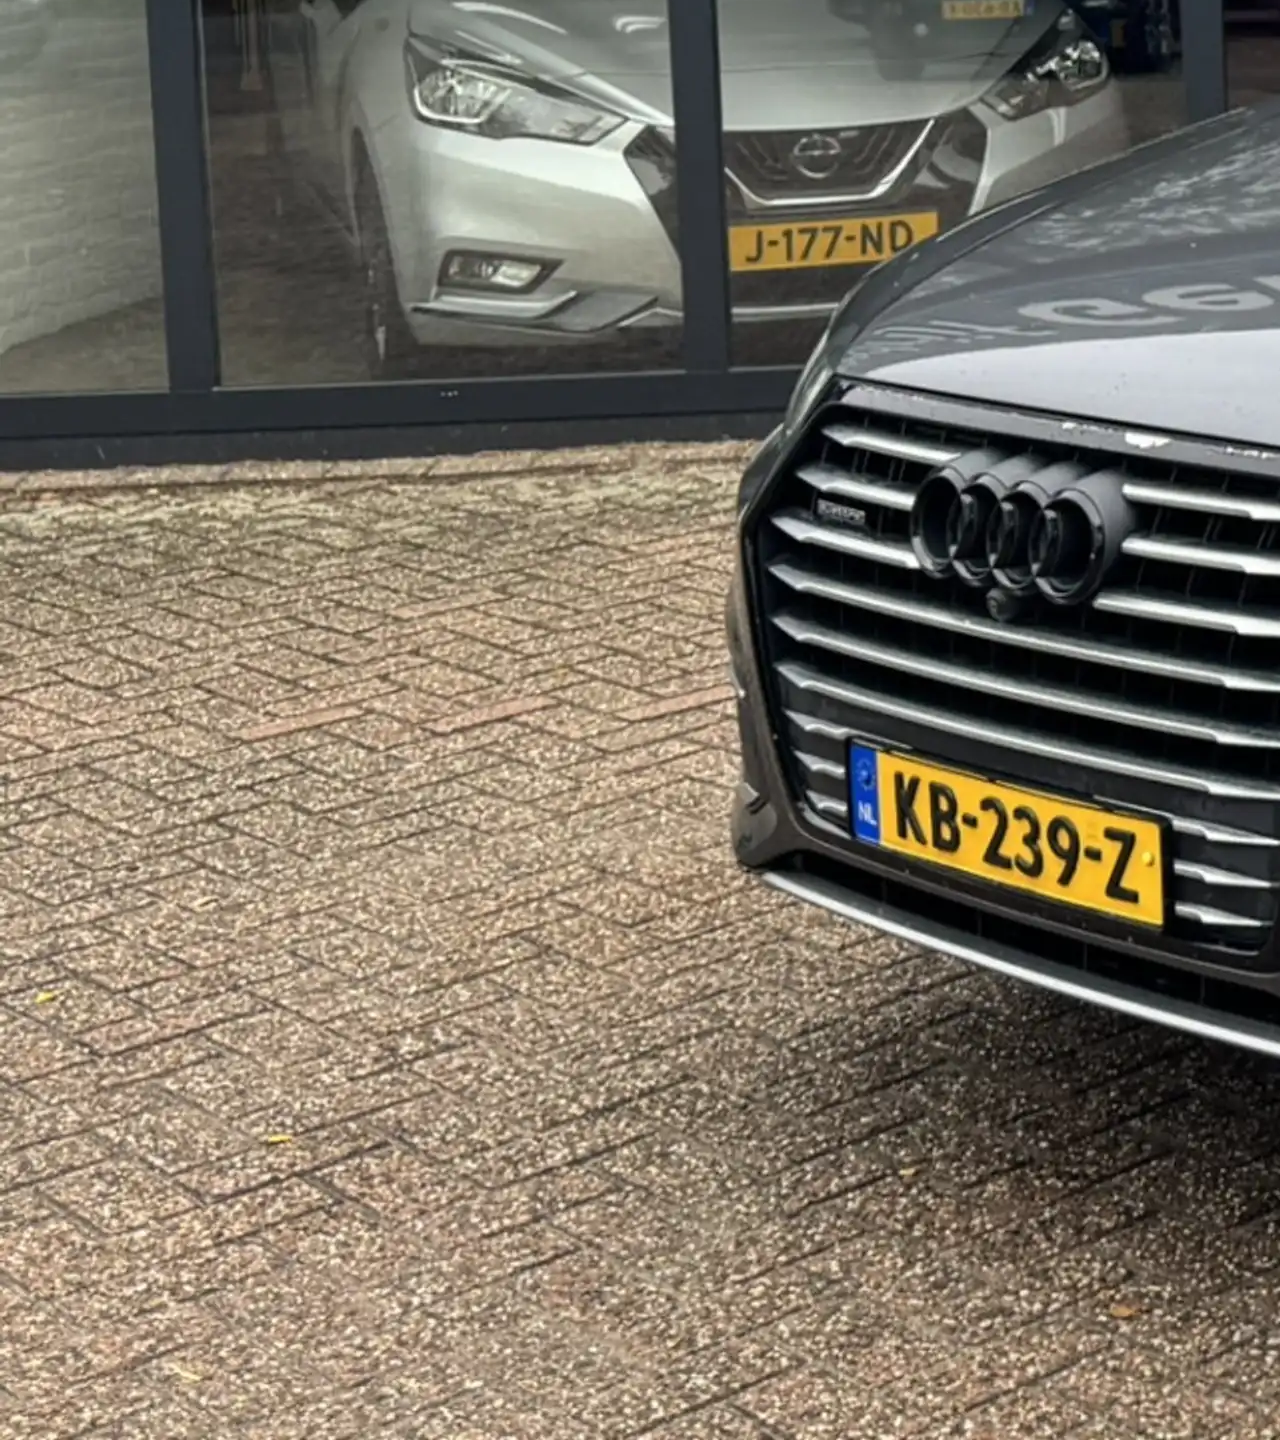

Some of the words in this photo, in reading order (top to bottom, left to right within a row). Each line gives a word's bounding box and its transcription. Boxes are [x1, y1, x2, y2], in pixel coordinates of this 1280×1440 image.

[745, 219, 914, 264] J-177-ND
[858, 800, 877, 826] NL
[894, 771, 1140, 904] KB-239-Z
